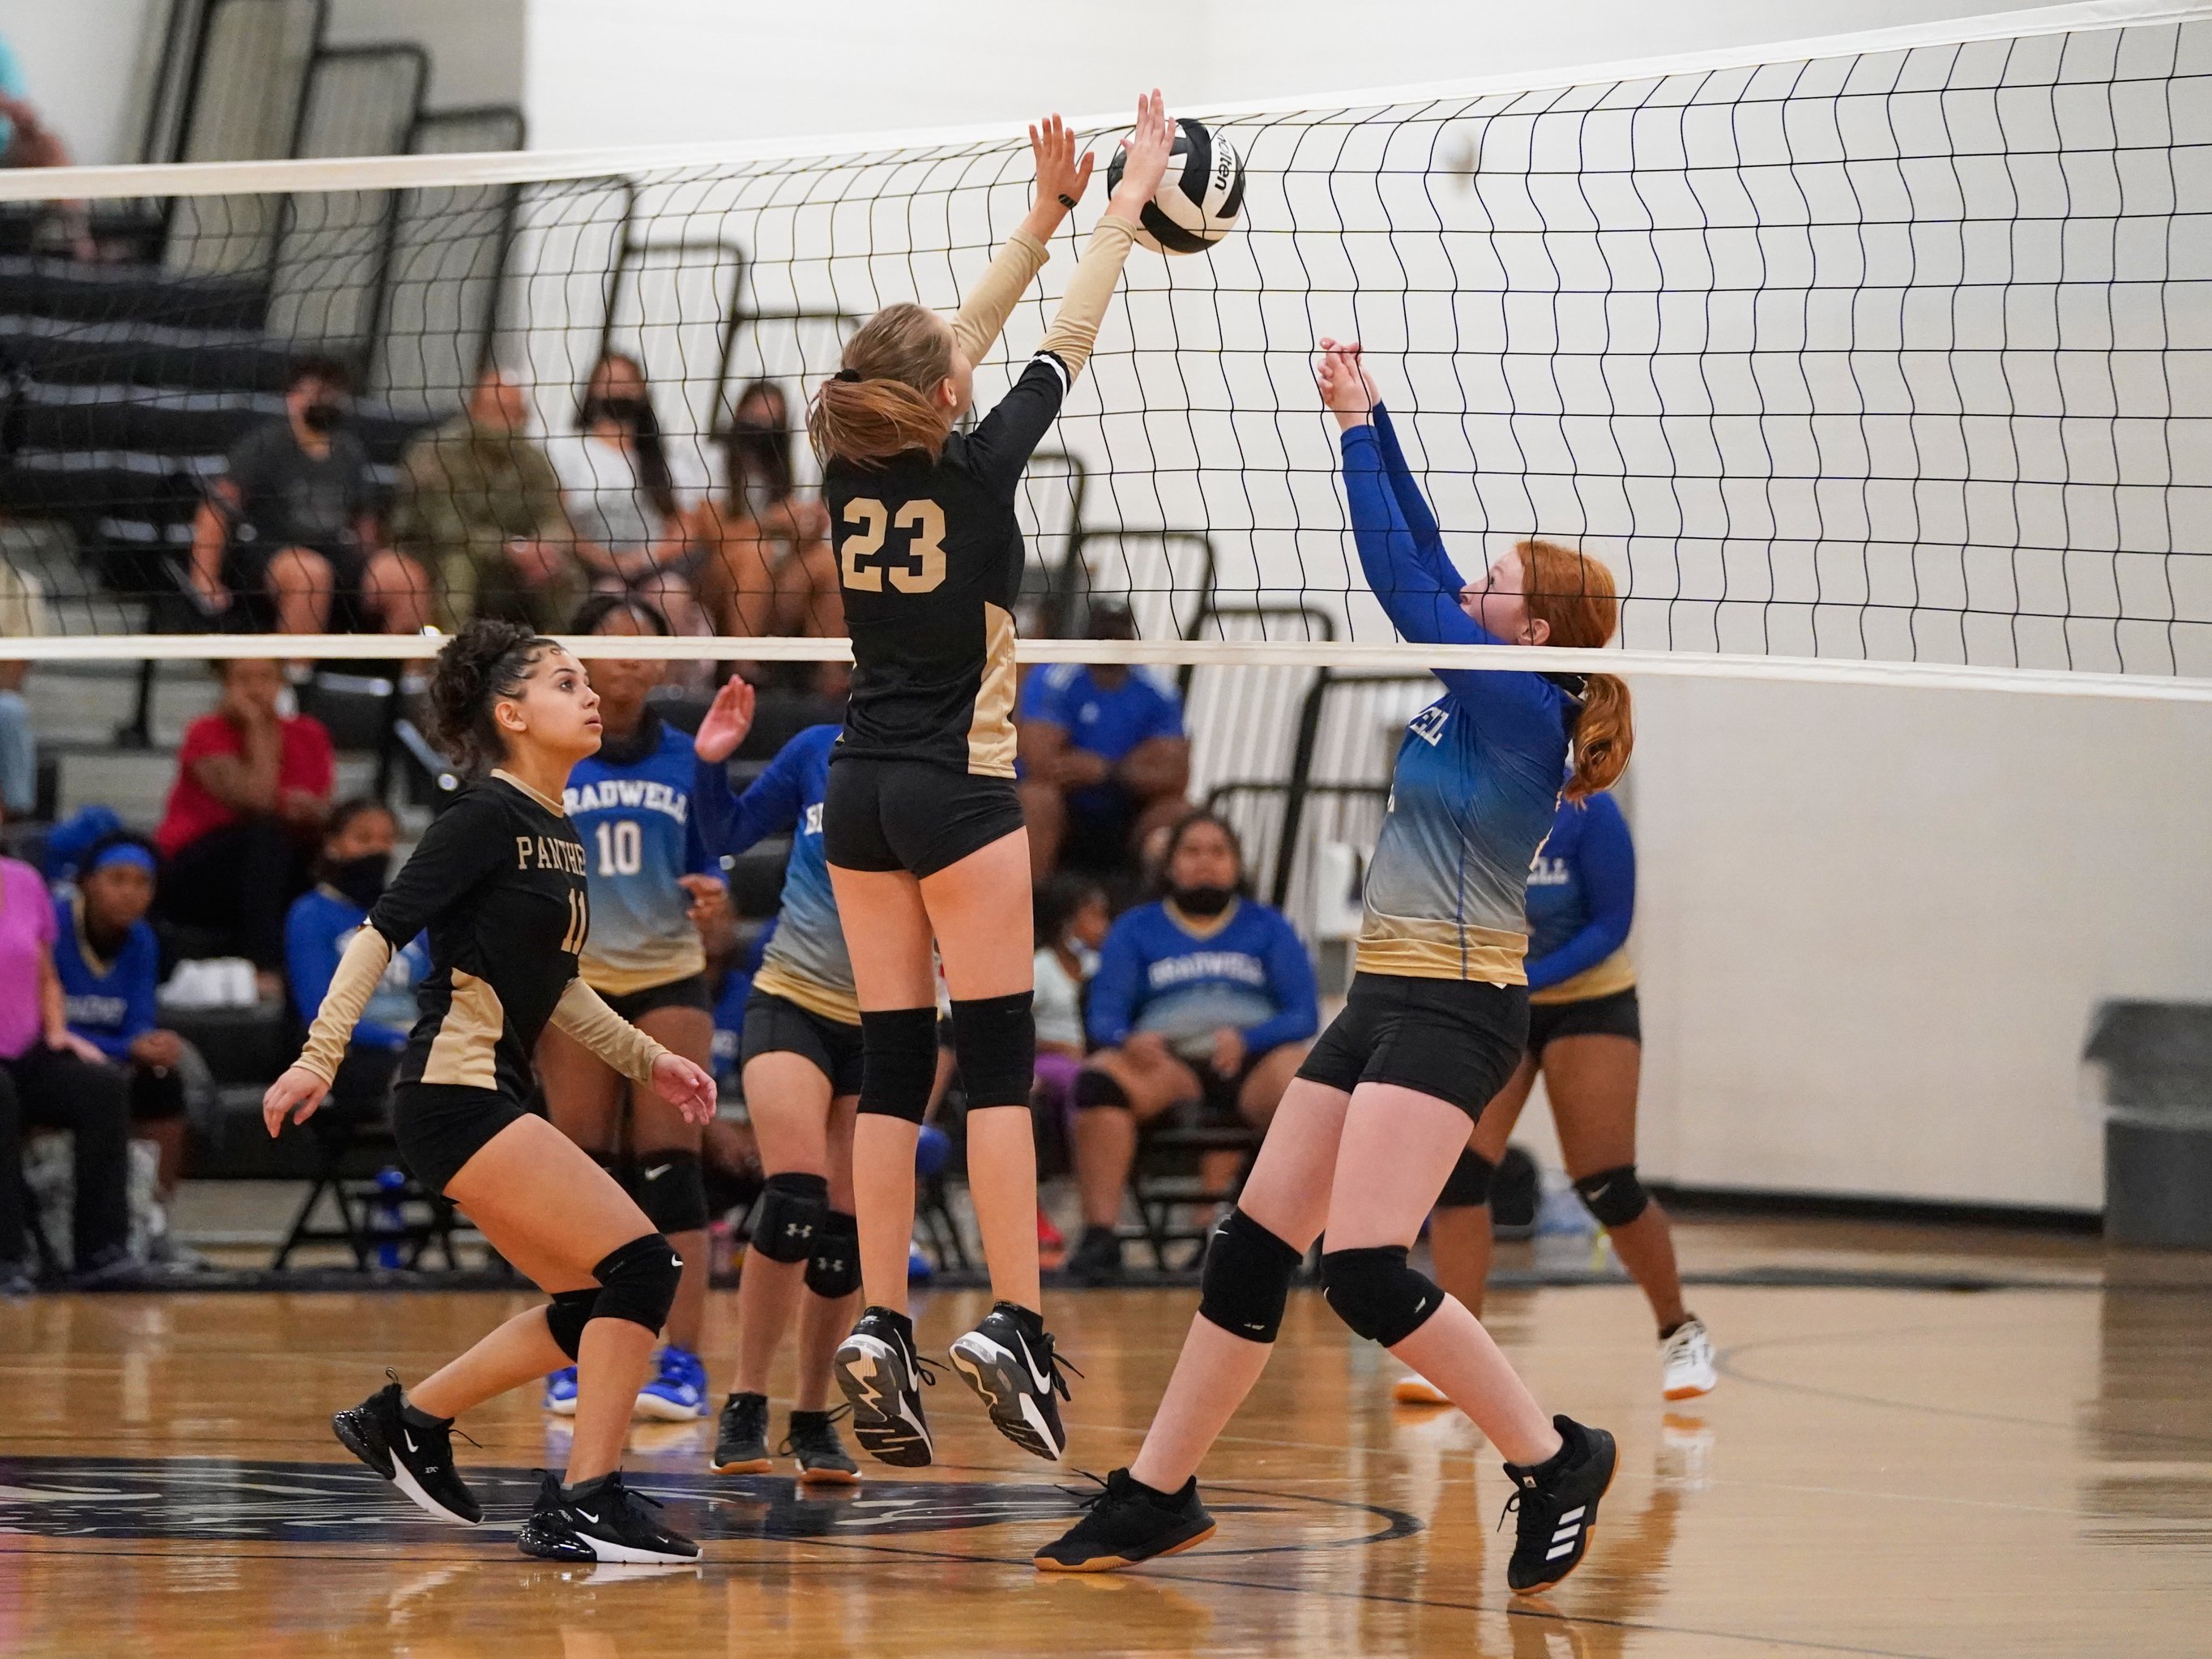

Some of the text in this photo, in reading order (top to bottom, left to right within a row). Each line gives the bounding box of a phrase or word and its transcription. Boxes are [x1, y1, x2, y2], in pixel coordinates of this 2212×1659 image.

[841, 497, 946, 594] 23
[562, 780, 688, 824] RADWELL
[516, 836, 586, 878] PANTHE
[596, 820, 642, 877] 10
[561, 887, 587, 956] 11
